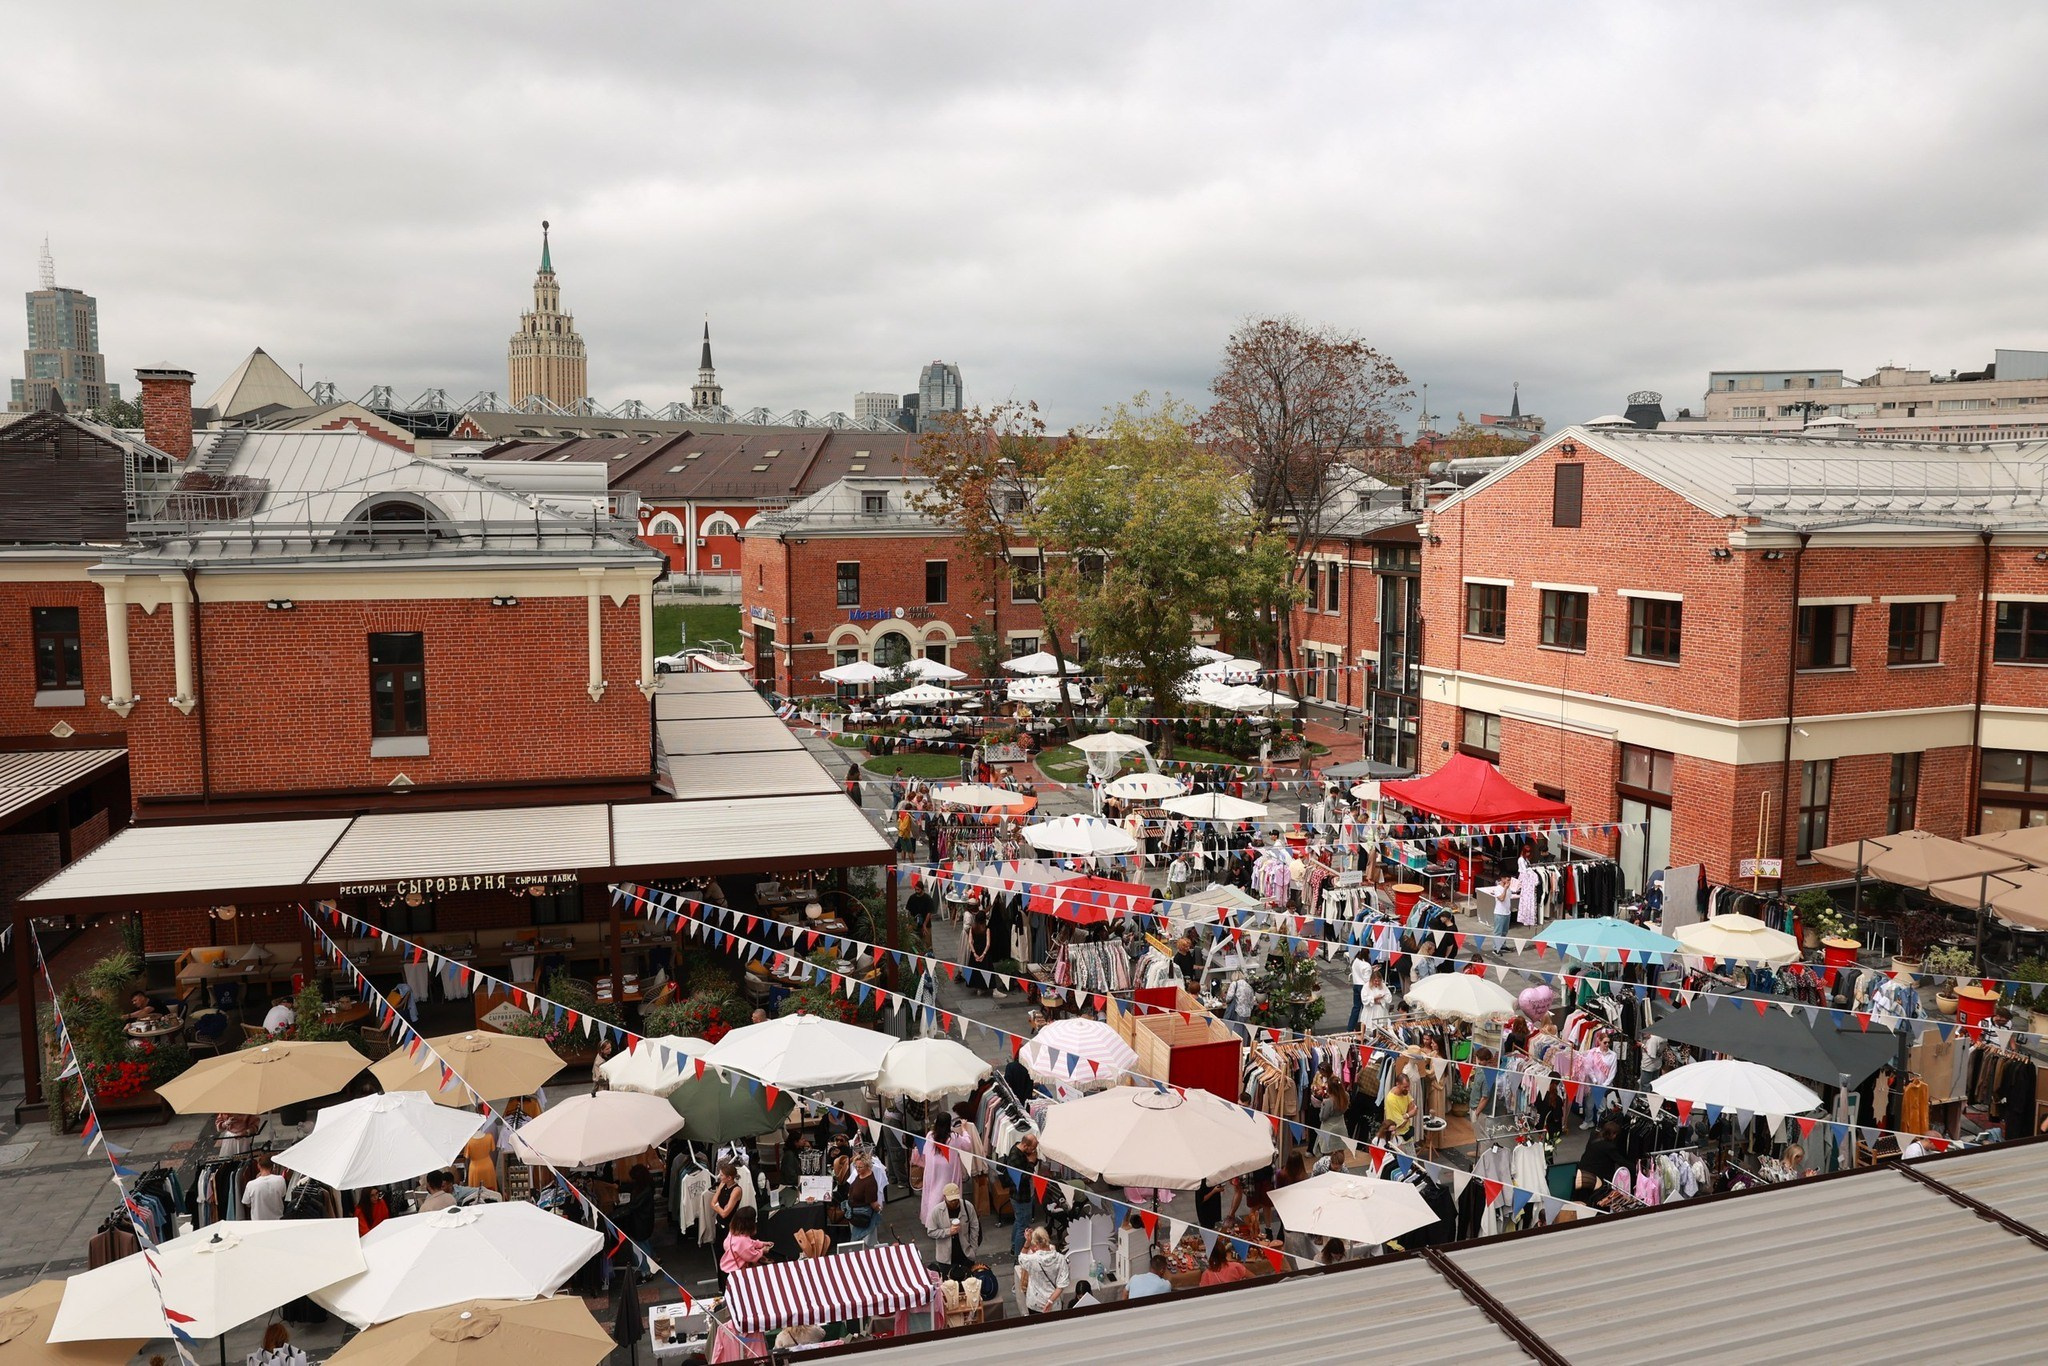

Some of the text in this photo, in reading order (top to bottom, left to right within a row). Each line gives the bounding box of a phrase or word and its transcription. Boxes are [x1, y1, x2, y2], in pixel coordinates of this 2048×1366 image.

[848, 607, 892, 620] Meraki
[340, 873, 578, 895] РЕСТОРАН СЫРОВАРНЯ СЫРНАЯ ЛАВКА
